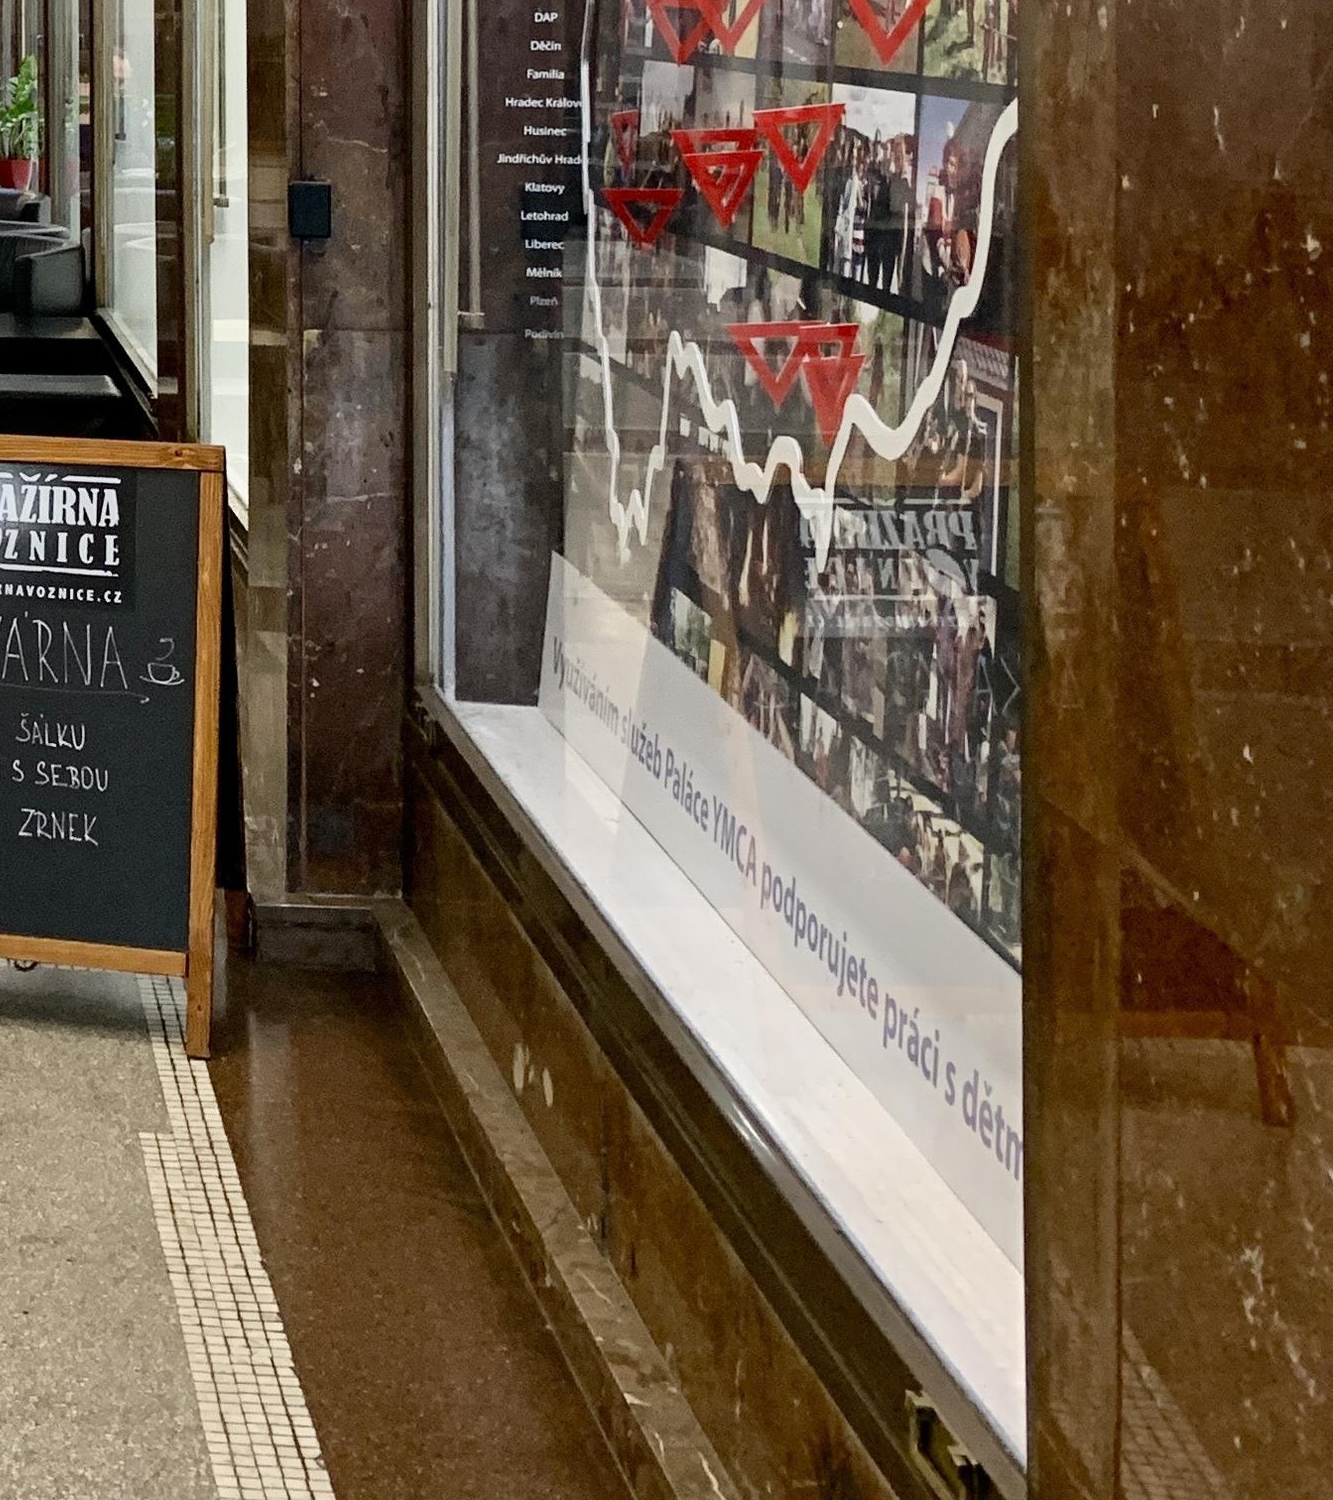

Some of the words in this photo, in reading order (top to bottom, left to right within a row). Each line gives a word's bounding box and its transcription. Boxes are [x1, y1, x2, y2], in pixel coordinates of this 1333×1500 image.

[534, 12, 559, 23] DAP
[530, 40, 562, 51] Děčín
[526, 68, 565, 79] Familia
[505, 97, 544, 108] Hradec
[545, 96, 583, 108] Králov
[523, 125, 568, 137] Husinec
[497, 153, 553, 165] Jindřichův
[554, 154, 587, 165] Hrad
[524, 182, 566, 196] Klatovy
[520, 210, 569, 222] Letohrad
[524, 239, 566, 250] Liberec
[526, 267, 563, 279] Mělník
[11, 760, 25, 784] S
[35, 762, 110, 792] SEBOU
[17, 807, 99, 846] ZRNEK
[620, 707, 663, 780] služeb
[664, 747, 710, 832] Paláce
[712, 795, 758, 888] YMCA
[760, 861, 880, 1020] podporujete
[882, 992, 941, 1089] práci
[944, 1060, 957, 1106] s
